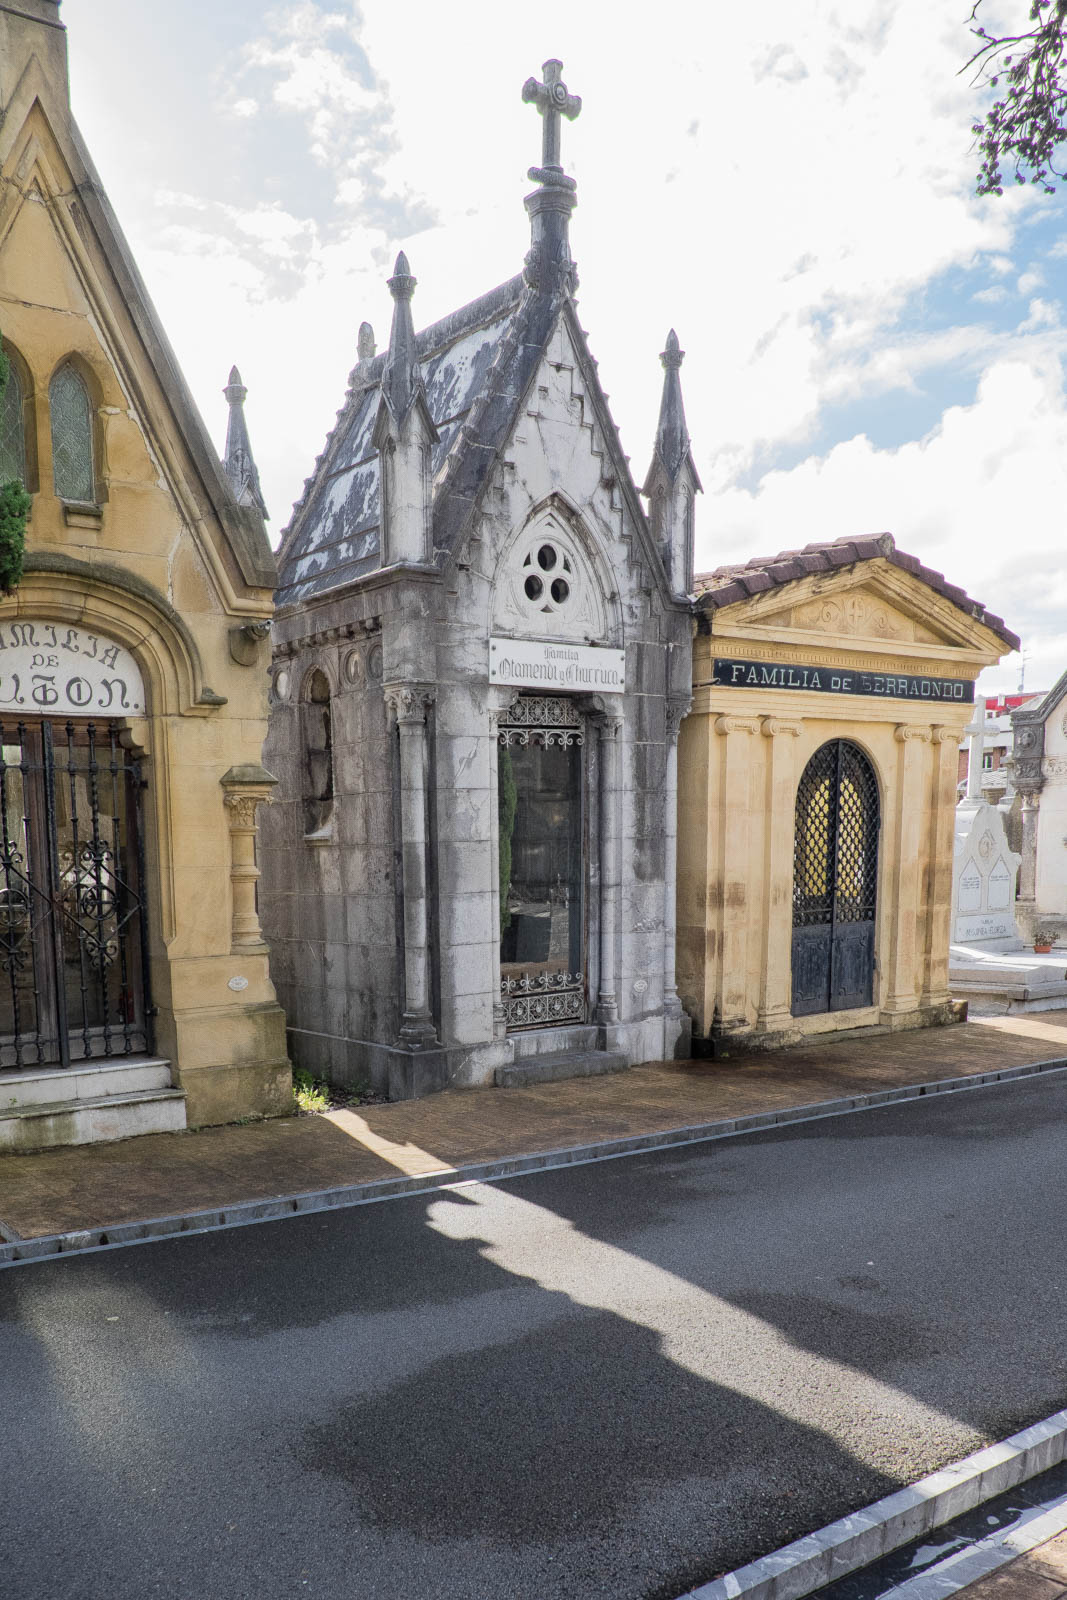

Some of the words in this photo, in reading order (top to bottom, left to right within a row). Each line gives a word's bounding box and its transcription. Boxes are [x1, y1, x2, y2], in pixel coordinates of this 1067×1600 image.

[30, 653, 59, 669] DE
[544, 646, 579, 660] Familia
[499, 658, 558, 680] Otamendi
[559, 669, 565, 685] y
[565, 663, 619, 685] Churruca
[731, 665, 822, 688] FAMILIA
